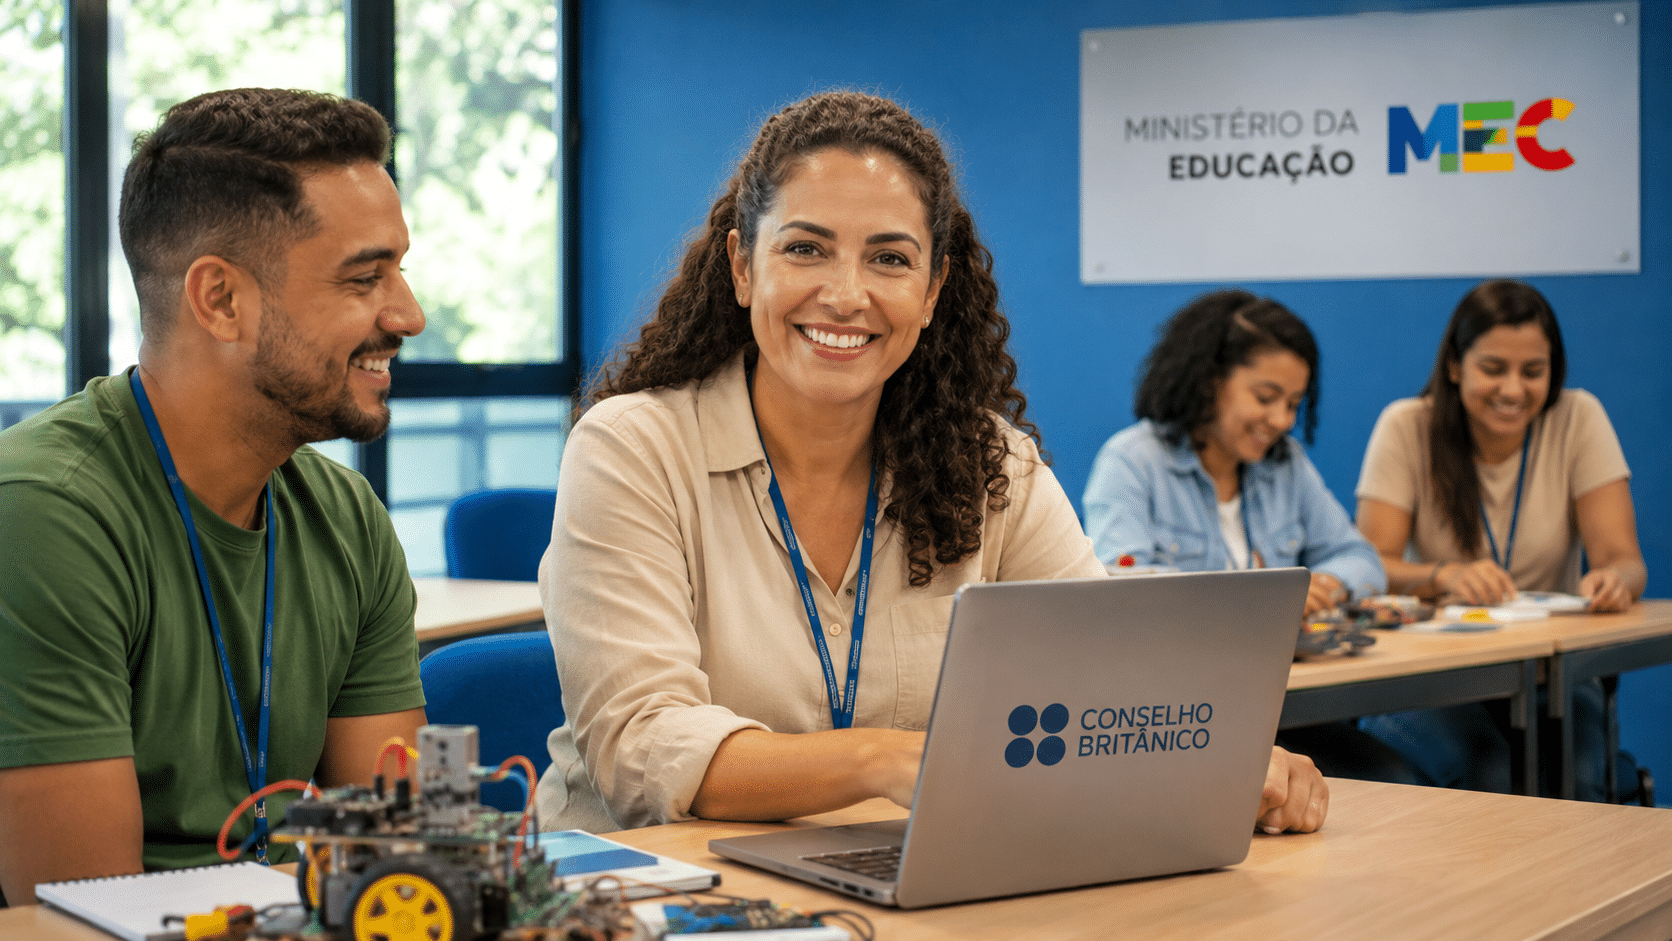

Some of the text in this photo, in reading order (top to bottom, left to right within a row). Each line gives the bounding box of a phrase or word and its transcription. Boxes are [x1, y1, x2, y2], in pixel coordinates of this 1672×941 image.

[1124, 106, 1359, 142] MINISTÉRIO DA
[1387, 97, 1576, 174] MEC
[1168, 145, 1354, 184] EDUCAÇÃO
[1081, 703, 1213, 731] CONSELHO
[1078, 728, 1210, 757] BRITÂNICO
